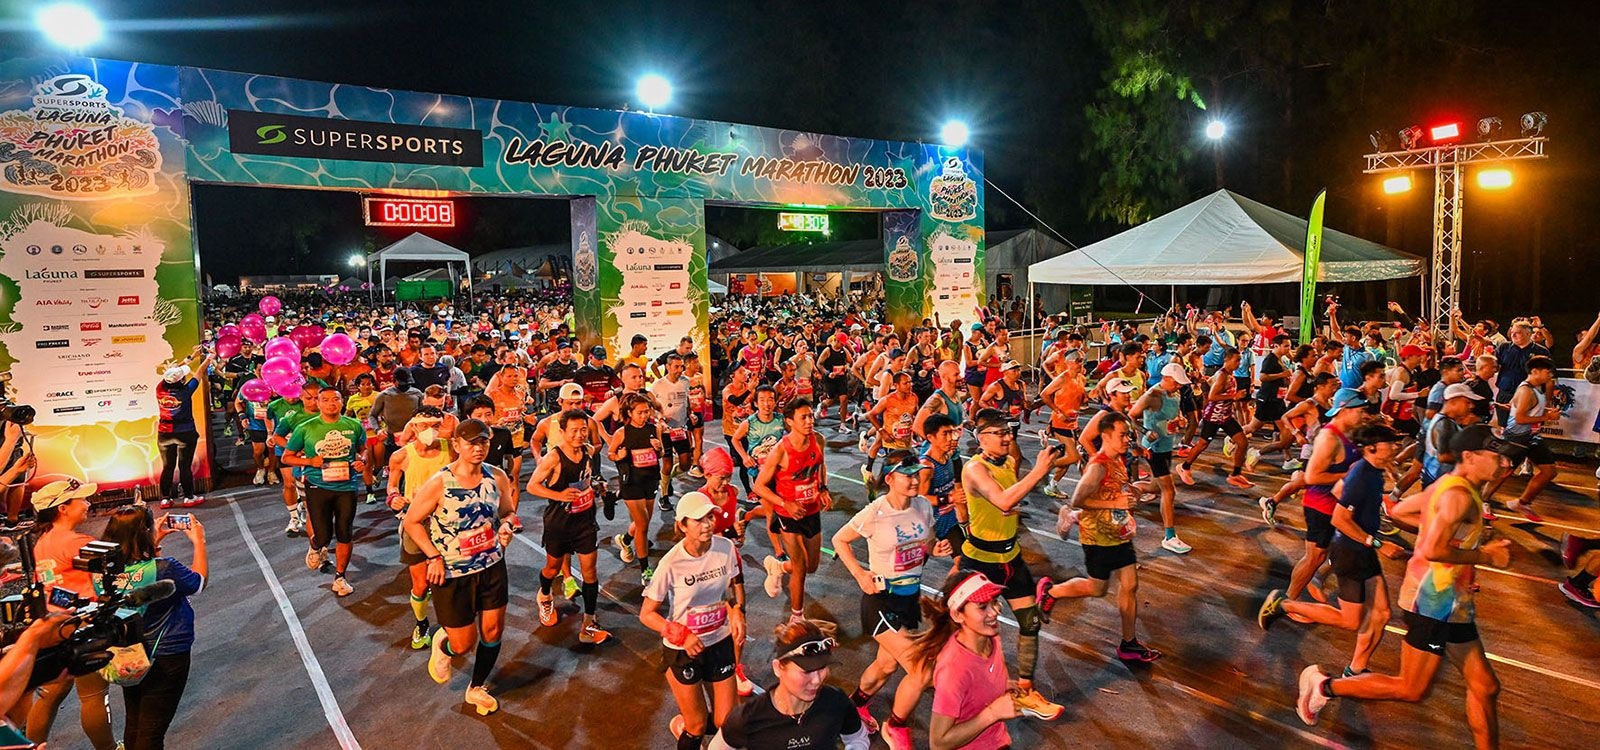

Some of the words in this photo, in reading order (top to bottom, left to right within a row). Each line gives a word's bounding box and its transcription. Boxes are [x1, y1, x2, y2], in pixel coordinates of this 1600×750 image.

[37, 98, 106, 108] SUPERSPORTS
[36, 110, 111, 124] LAGUNA
[27, 125, 118, 150] PHUKET
[294, 128, 463, 155] SUPERSPORTS
[33, 140, 130, 167] MARATHON
[504, 137, 626, 170] LAGUNA
[633, 144, 737, 176] PHUKET
[740, 155, 860, 186] MARATHON
[863, 165, 908, 190] 2023
[50, 173, 112, 192] 2023
[25, 268, 79, 280] Laguna
[468, 532, 488, 546] 165
[901, 547, 923, 562] 1182
[696, 571, 722, 584] PROJECT
[693, 610, 722, 626] 1021
